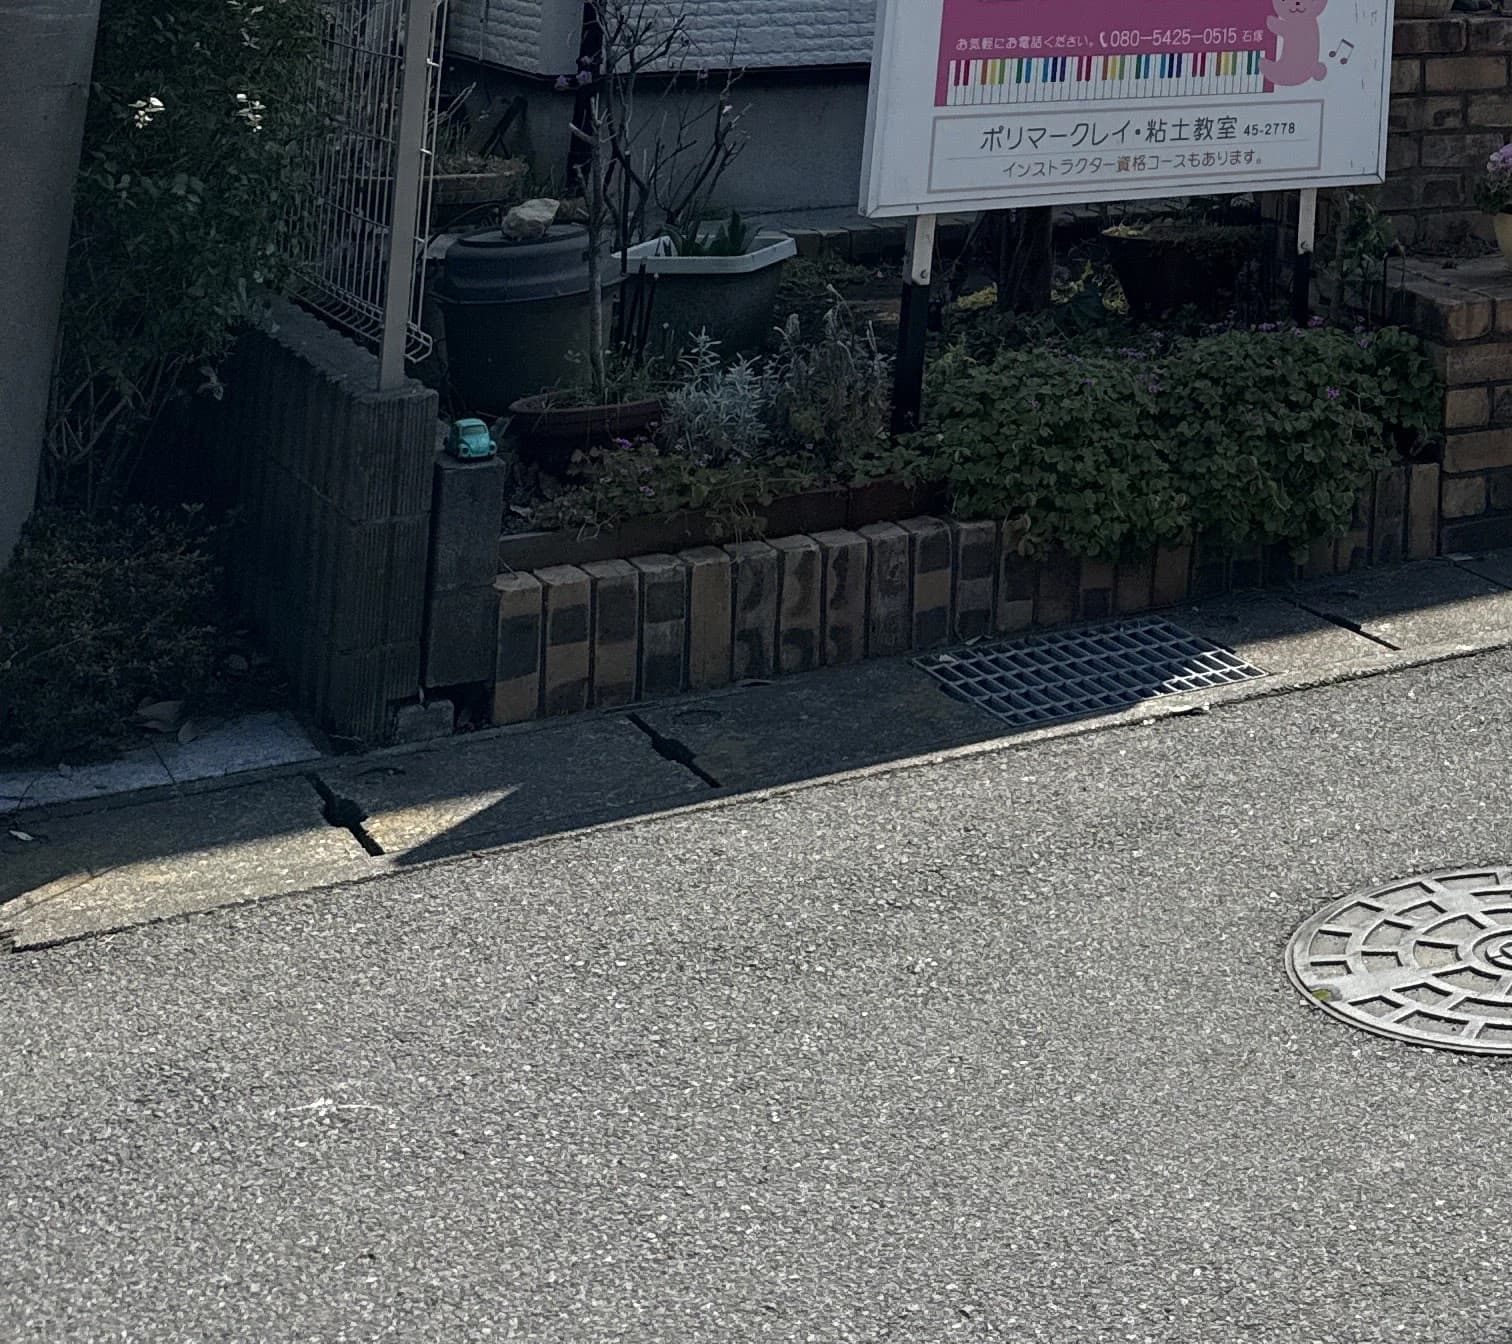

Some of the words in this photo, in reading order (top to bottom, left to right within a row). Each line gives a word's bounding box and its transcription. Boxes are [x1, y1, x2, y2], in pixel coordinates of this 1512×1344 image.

[980, 115, 1238, 152] ポリマークレイ・粘土教室
[1243, 122, 1295, 137] 45-2778
[1002, 148, 1262, 178] インストラクター資格コースもあります。
